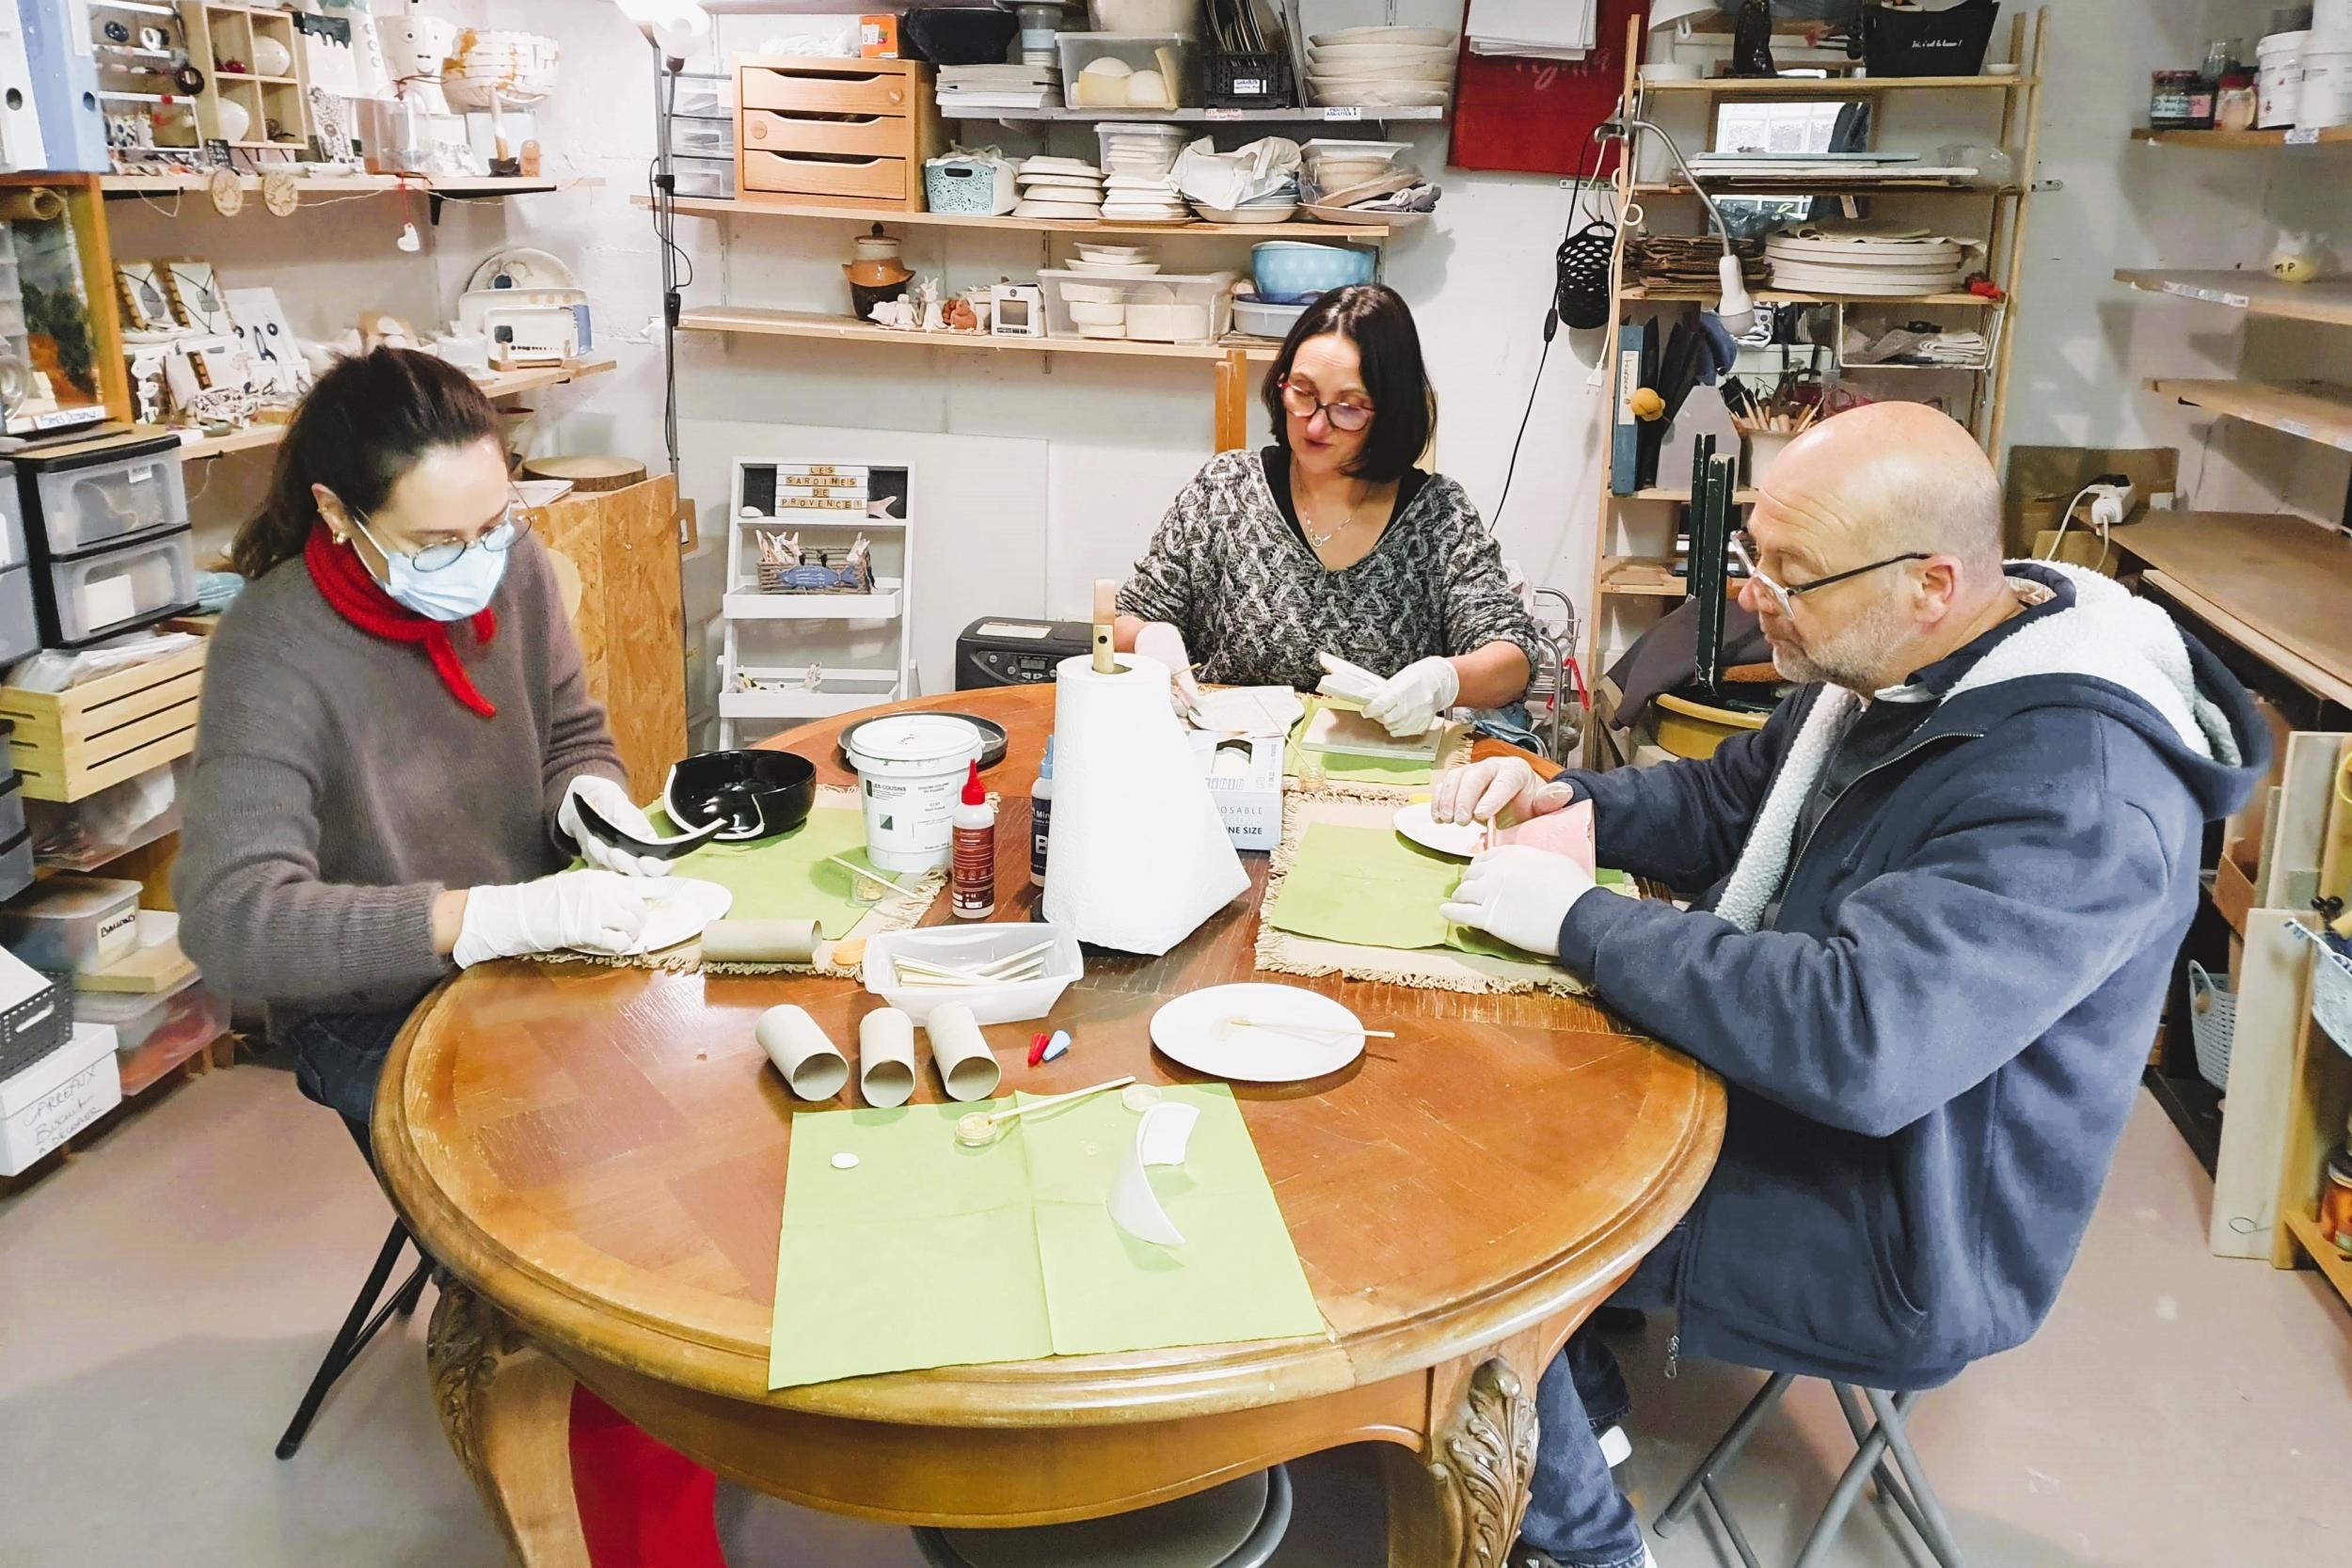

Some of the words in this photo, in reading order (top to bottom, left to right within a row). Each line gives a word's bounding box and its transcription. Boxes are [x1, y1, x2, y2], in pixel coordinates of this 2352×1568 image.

[787, 476, 856, 486] SARDINES
[1220, 806, 1263, 816] OSABLE
[1226, 826, 1241, 834] NE
[1243, 827, 1263, 835] SIZE
